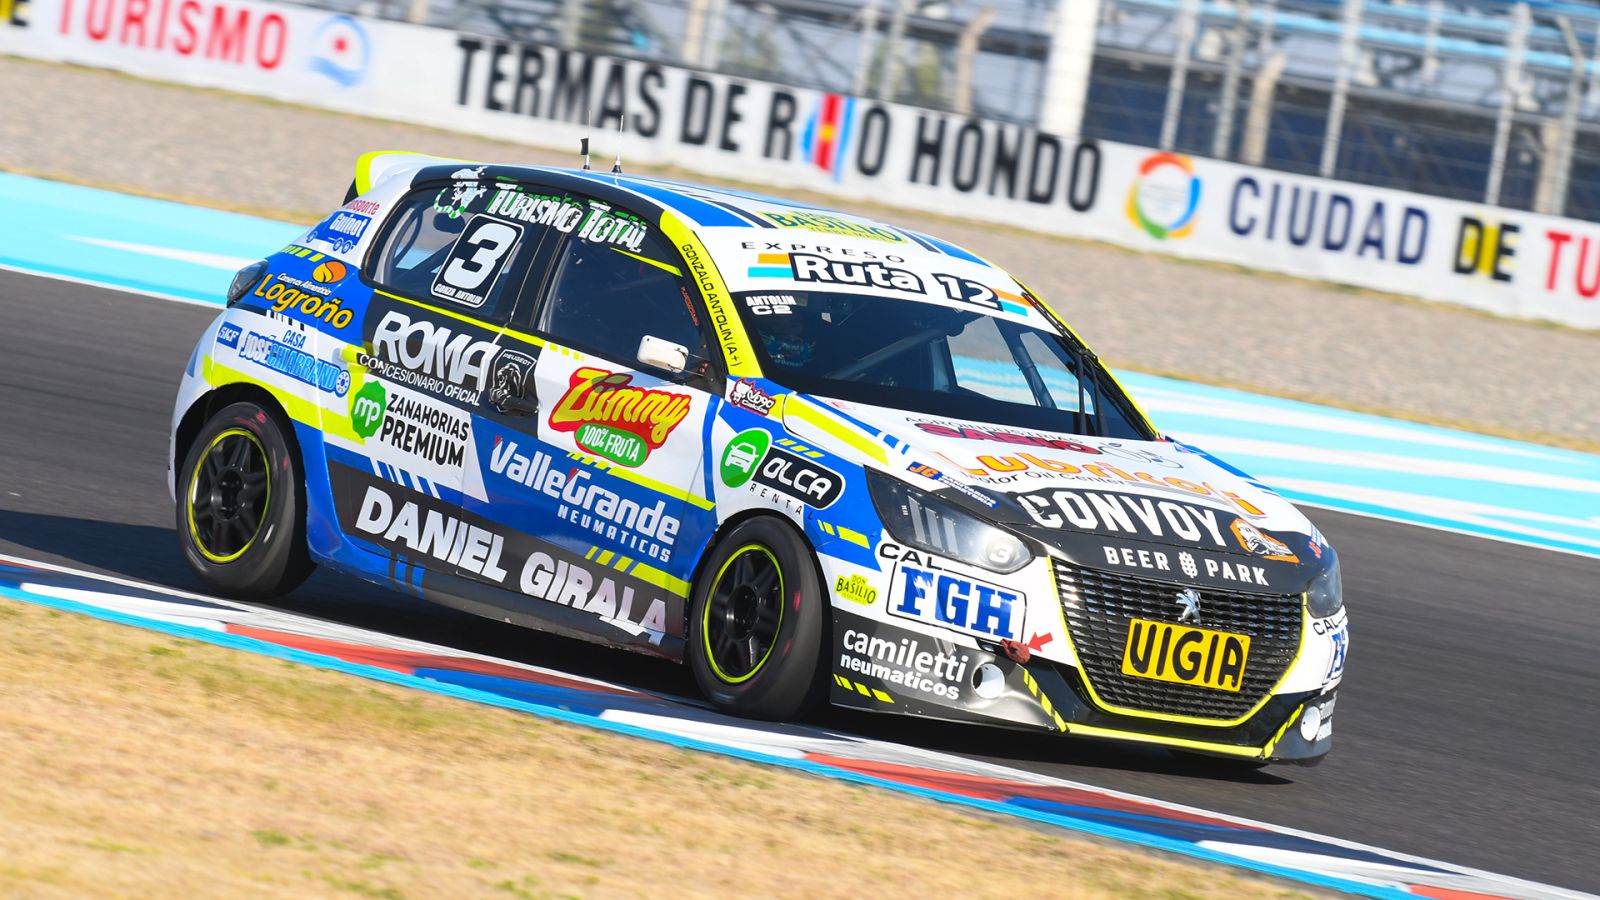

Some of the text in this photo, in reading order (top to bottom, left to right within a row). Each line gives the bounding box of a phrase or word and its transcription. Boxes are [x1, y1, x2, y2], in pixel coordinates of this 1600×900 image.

[457, 39, 664, 138] TERMAS
[679, 77, 748, 152] DE
[909, 115, 1103, 213] HONDO
[485, 180, 647, 253] TURISMO TOTAL
[764, 212, 903, 242] BASILIO
[1228, 176, 1430, 265] CIUDAD
[1452, 215, 1521, 283] DE
[443, 222, 517, 290] 3
[741, 240, 905, 264] EXPRESO
[254, 273, 354, 330] Logroño
[682, 243, 715, 292] GONZALO
[707, 293, 733, 342] ANTOLIN
[745, 295, 797, 306] ANTOLIN
[789, 252, 1004, 312] Ruta 12
[219, 326, 239, 342] SKF
[752, 305, 793, 315] C2
[282, 330, 307, 349] CASA
[372, 310, 502, 391] ROMA
[502, 353, 532, 366] PEUGEOT
[359, 354, 481, 407] CONCESIONARIO OFICIAL
[386, 394, 470, 442] ZANAHORIAS
[380, 417, 465, 468] PREMIUM
[580, 424, 641, 462] 100% FRUTA
[909, 464, 939, 478] JC
[1025, 470, 1055, 480] Oil
[1059, 473, 1125, 486] Center
[750, 483, 813, 520] RENTAL
[1017, 491, 1227, 547] CONVOY
[557, 504, 671, 563] NEUMATICOS
[879, 543, 943, 571] CAL
[355, 485, 667, 646] DANIEL GIRALA
[1103, 546, 1269, 587] BEER PARK
[836, 577, 876, 604] BASILIO
[897, 566, 1018, 639] FGH
[840, 653, 960, 701] neumaticos
[843, 629, 969, 683] camiletti
